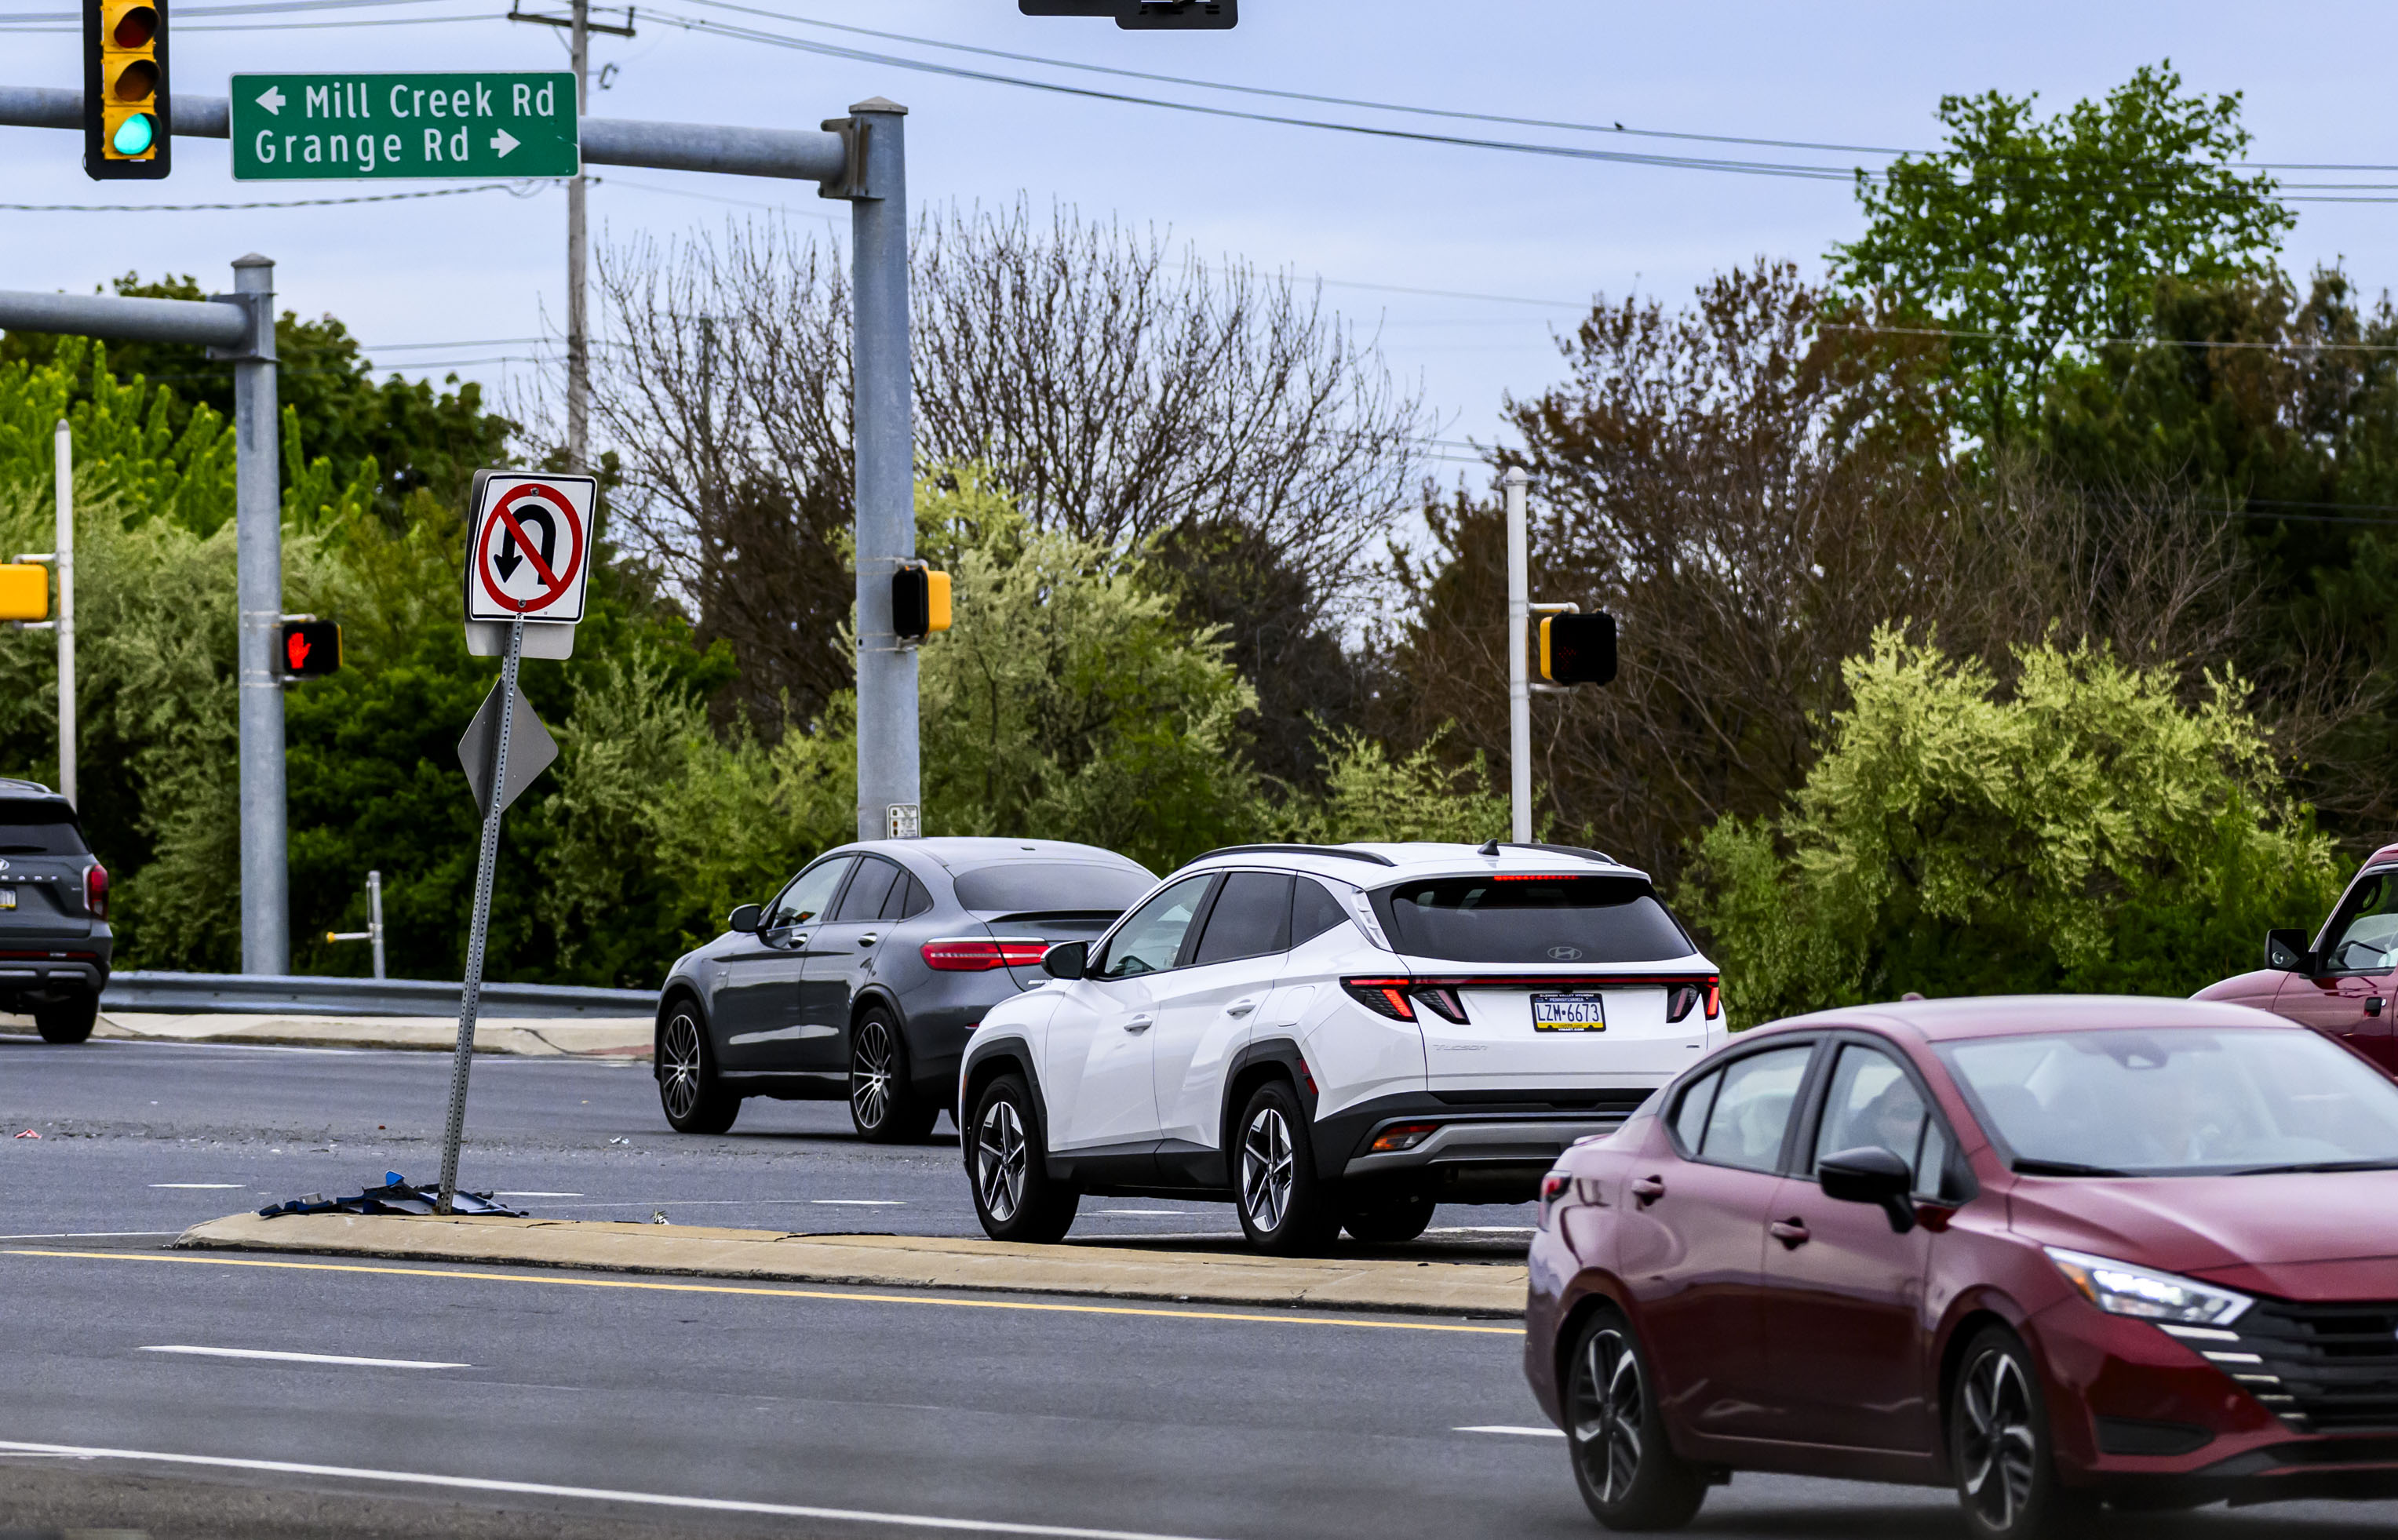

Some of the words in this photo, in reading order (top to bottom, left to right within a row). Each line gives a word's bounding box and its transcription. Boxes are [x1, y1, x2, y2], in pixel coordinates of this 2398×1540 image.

[306, 82, 370, 118] Mill
[390, 81, 494, 118] Creek
[512, 81, 555, 118] Rd
[255, 129, 403, 173] Grange
[424, 126, 469, 162] Rd
